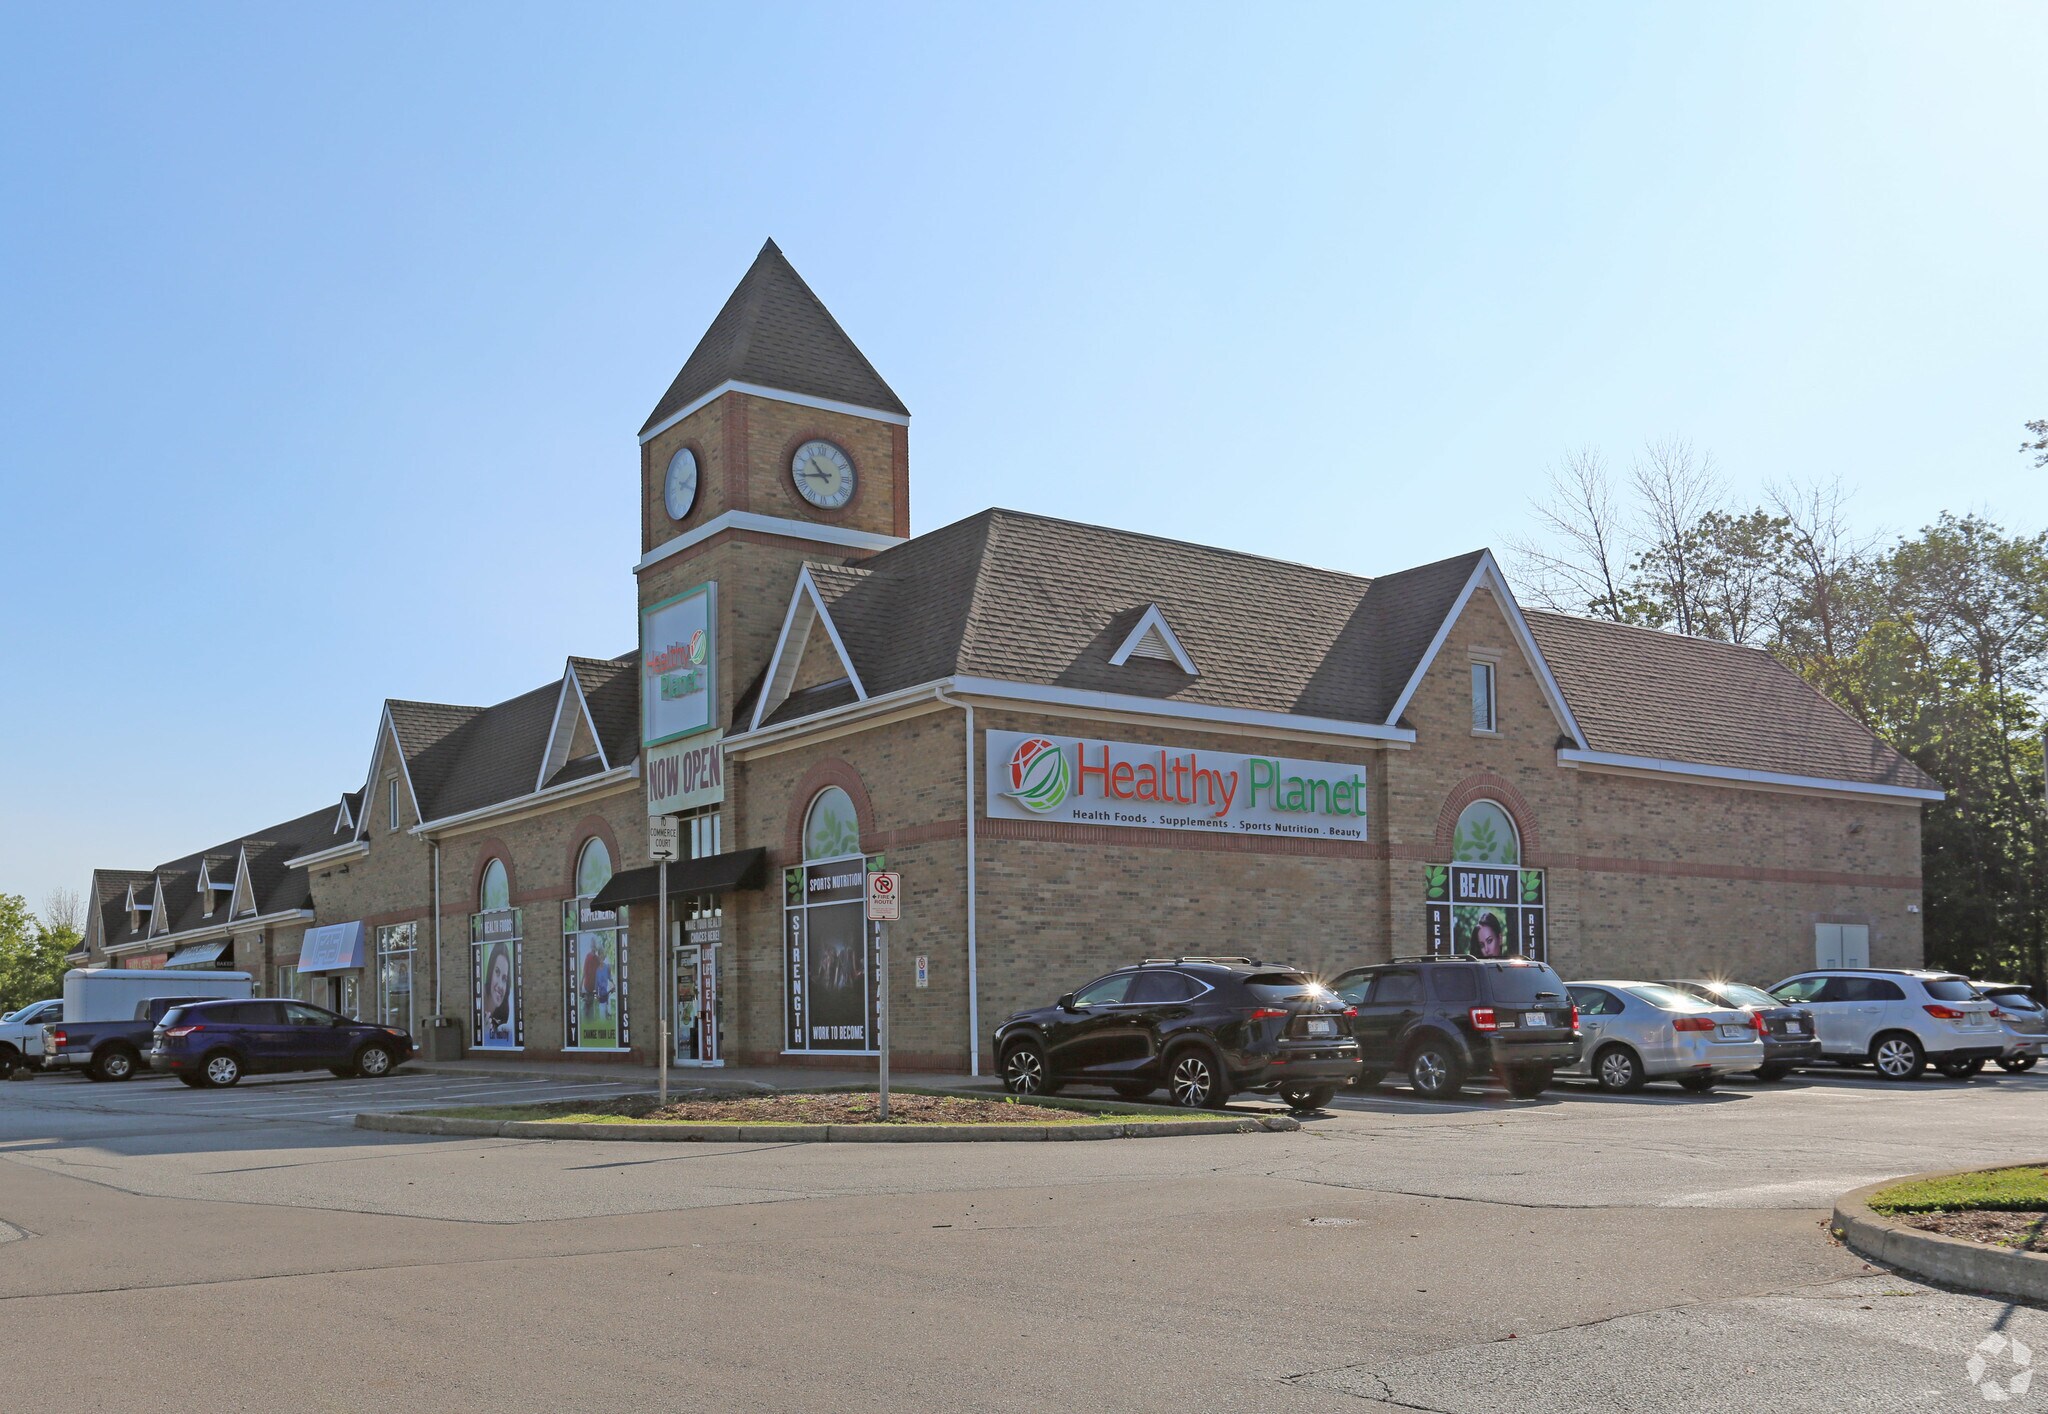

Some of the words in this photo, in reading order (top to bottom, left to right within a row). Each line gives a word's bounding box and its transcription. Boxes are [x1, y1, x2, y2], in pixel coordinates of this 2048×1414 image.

[648, 755, 679, 802] NOW
[683, 744, 721, 794] OPEN
[1077, 742, 1238, 817] Healthy
[1249, 758, 1366, 817] Planet
[650, 828, 676, 838] COMMERCE
[1072, 809, 1110, 820] Health
[1114, 812, 1147, 823] Foods
[1159, 815, 1228, 828] Supplements
[1239, 820, 1271, 832] Sports
[1275, 823, 1319, 834] Nutrition
[1329, 827, 1361, 839] Beauty
[655, 838, 671, 848] COURT
[810, 876, 831, 891] SPORTS
[832, 872, 862, 888] NUTRITION
[1459, 872, 1509, 899] BEAUTY
[621, 933, 629, 1043] NOURISH
[792, 915, 802, 1043] STRENGTH
[813, 1025, 829, 1040] WORK
[831, 1025, 838, 1040] TO
[840, 1025, 864, 1040] BECOME
